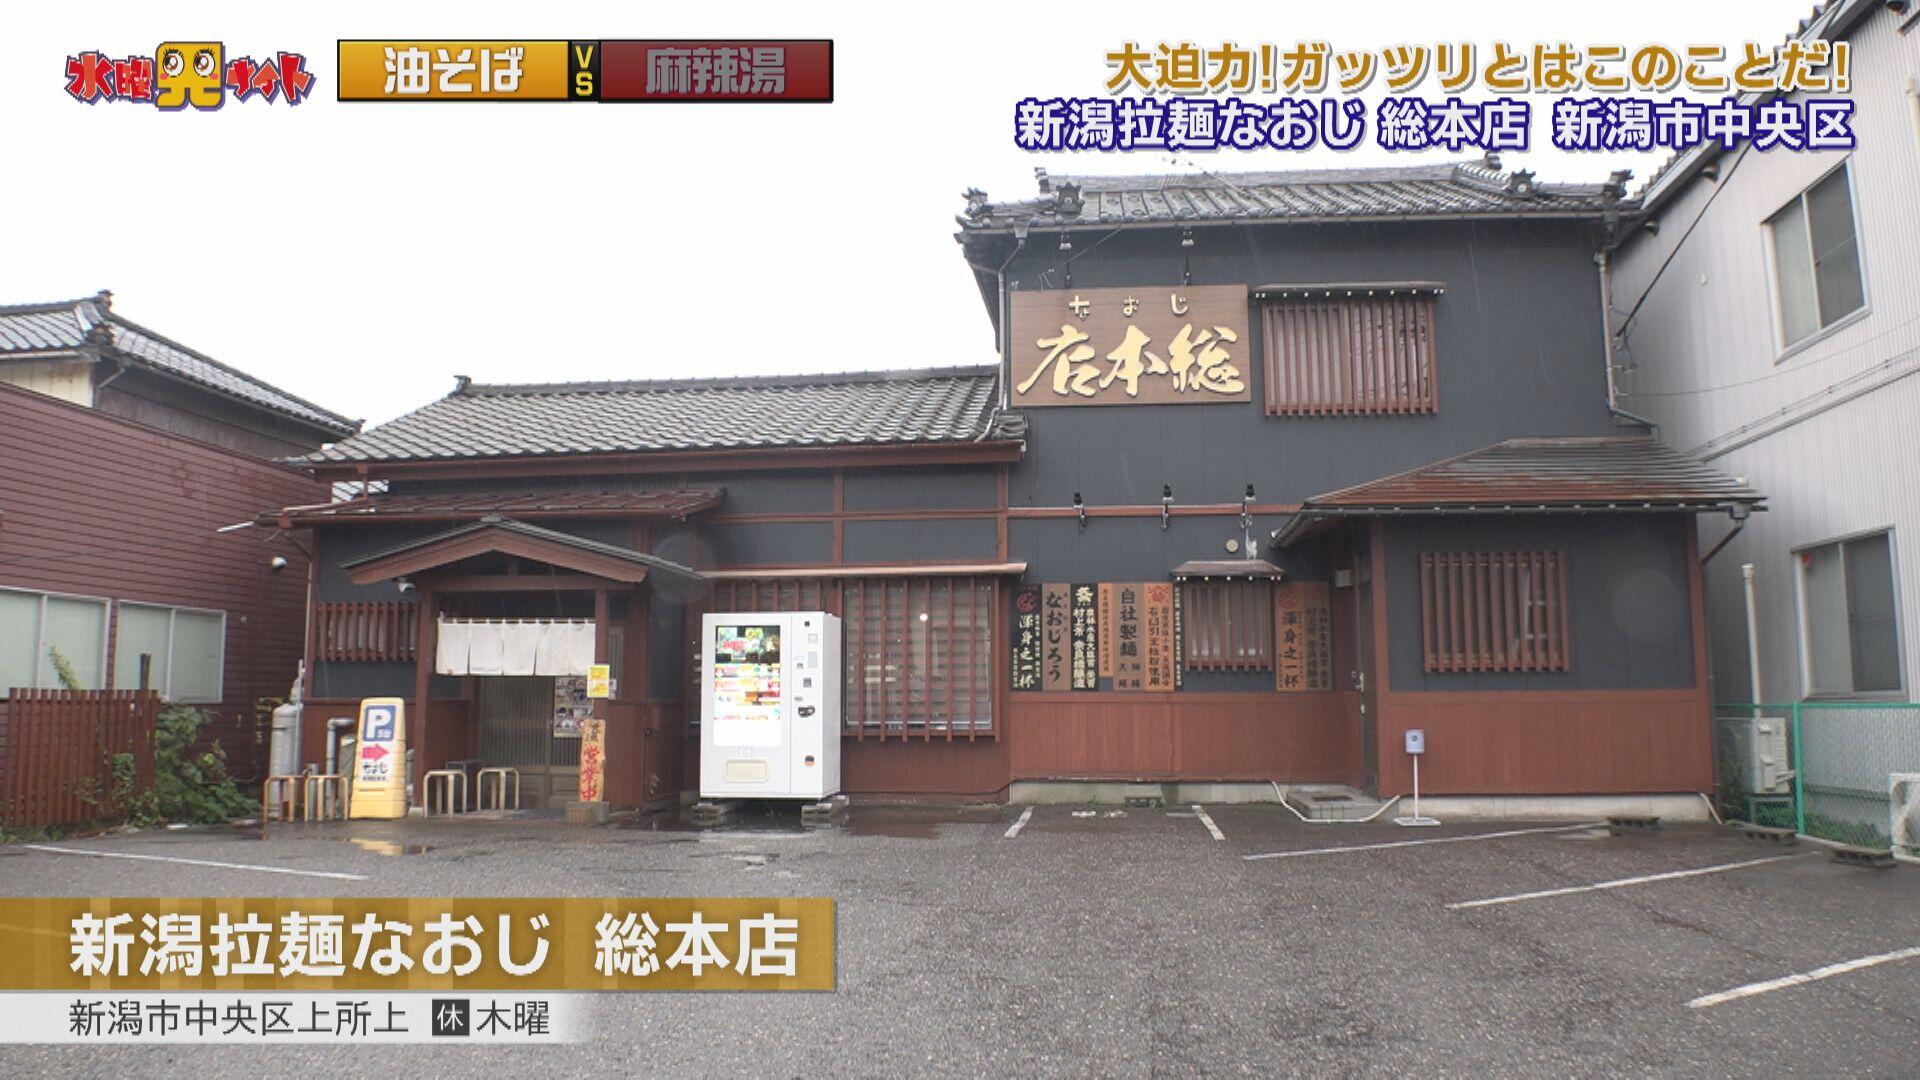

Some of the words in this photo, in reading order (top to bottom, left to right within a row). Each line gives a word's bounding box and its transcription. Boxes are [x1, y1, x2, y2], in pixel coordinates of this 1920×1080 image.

[1069, 293, 1188, 320] なおじ
[1046, 591, 1062, 682] なおじろう
[366, 708, 391, 738] P
